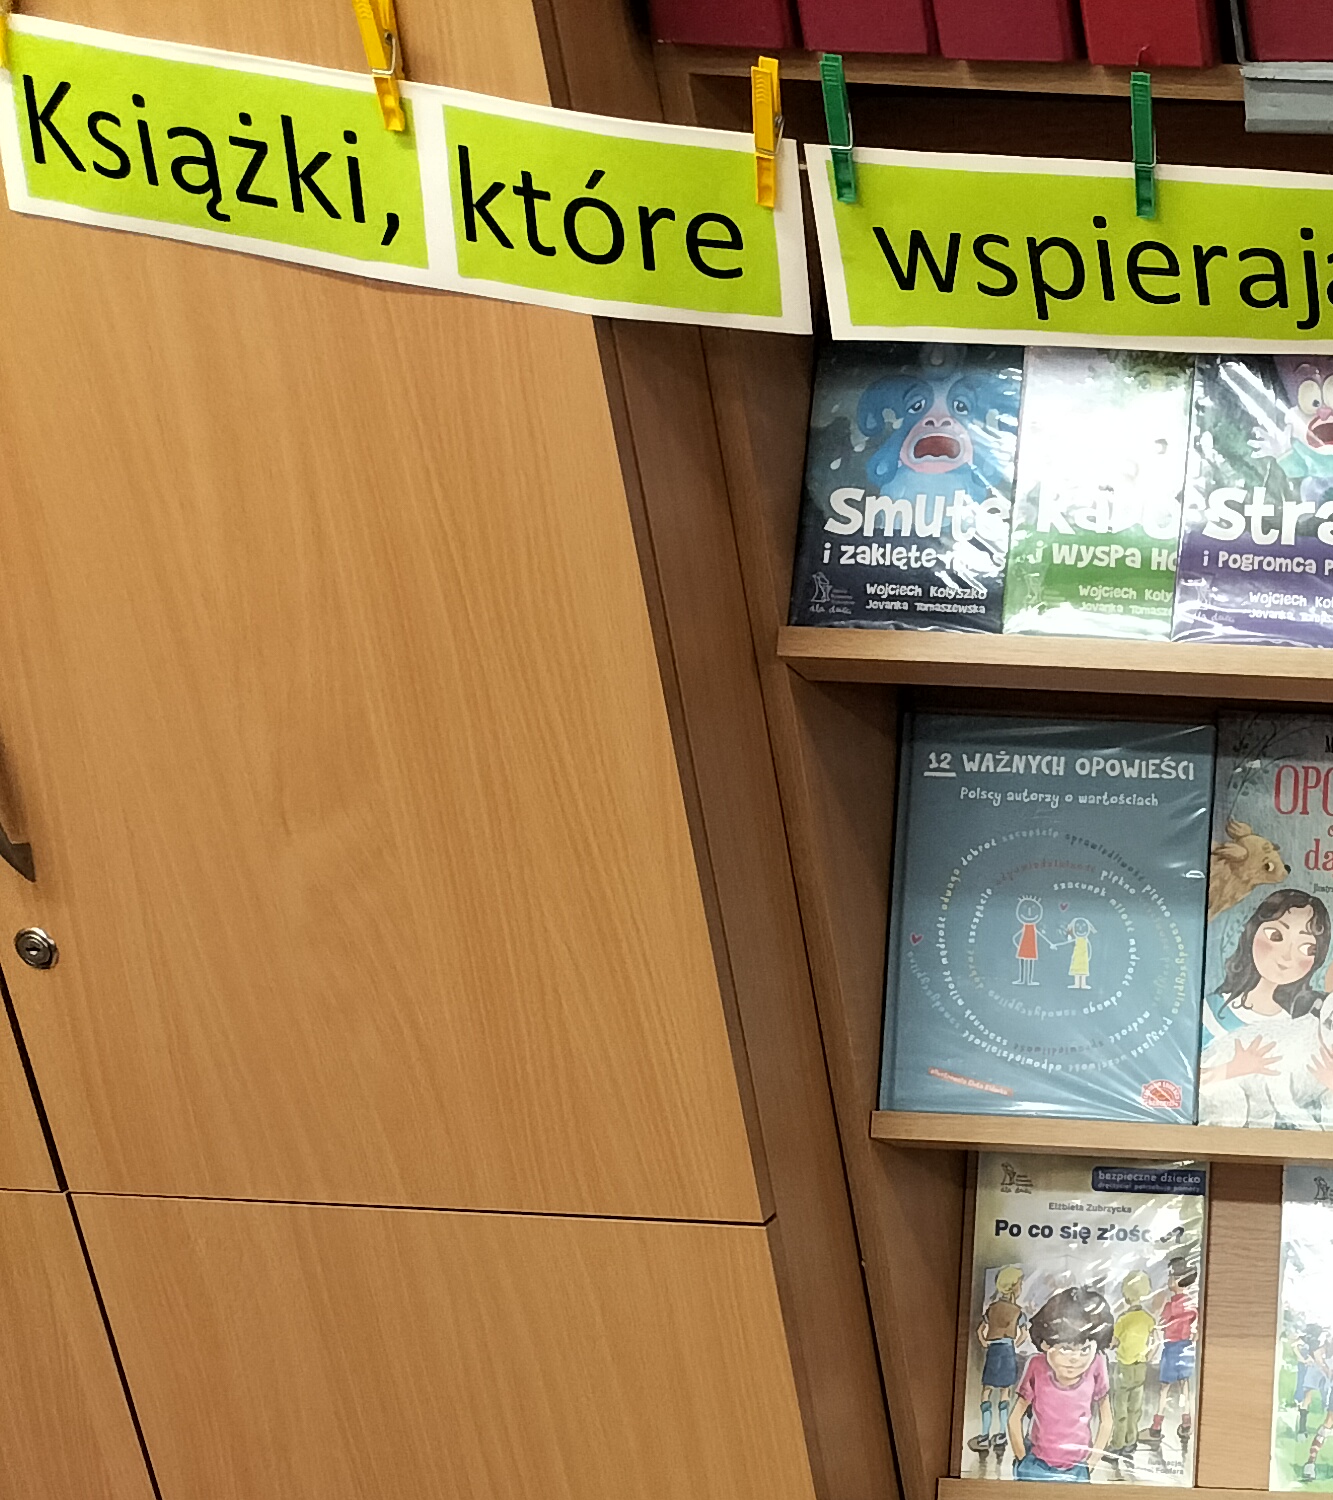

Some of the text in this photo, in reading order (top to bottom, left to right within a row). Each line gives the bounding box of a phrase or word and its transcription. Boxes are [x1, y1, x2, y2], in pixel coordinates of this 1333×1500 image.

[23, 74, 745, 281] Książki, które
[963, 751, 1195, 781] WAŻNYCH OPOWIEŚCI
[960, 787, 1159, 809] Polscy autorzy wartościach
[1058, 1223, 1090, 1244] się
